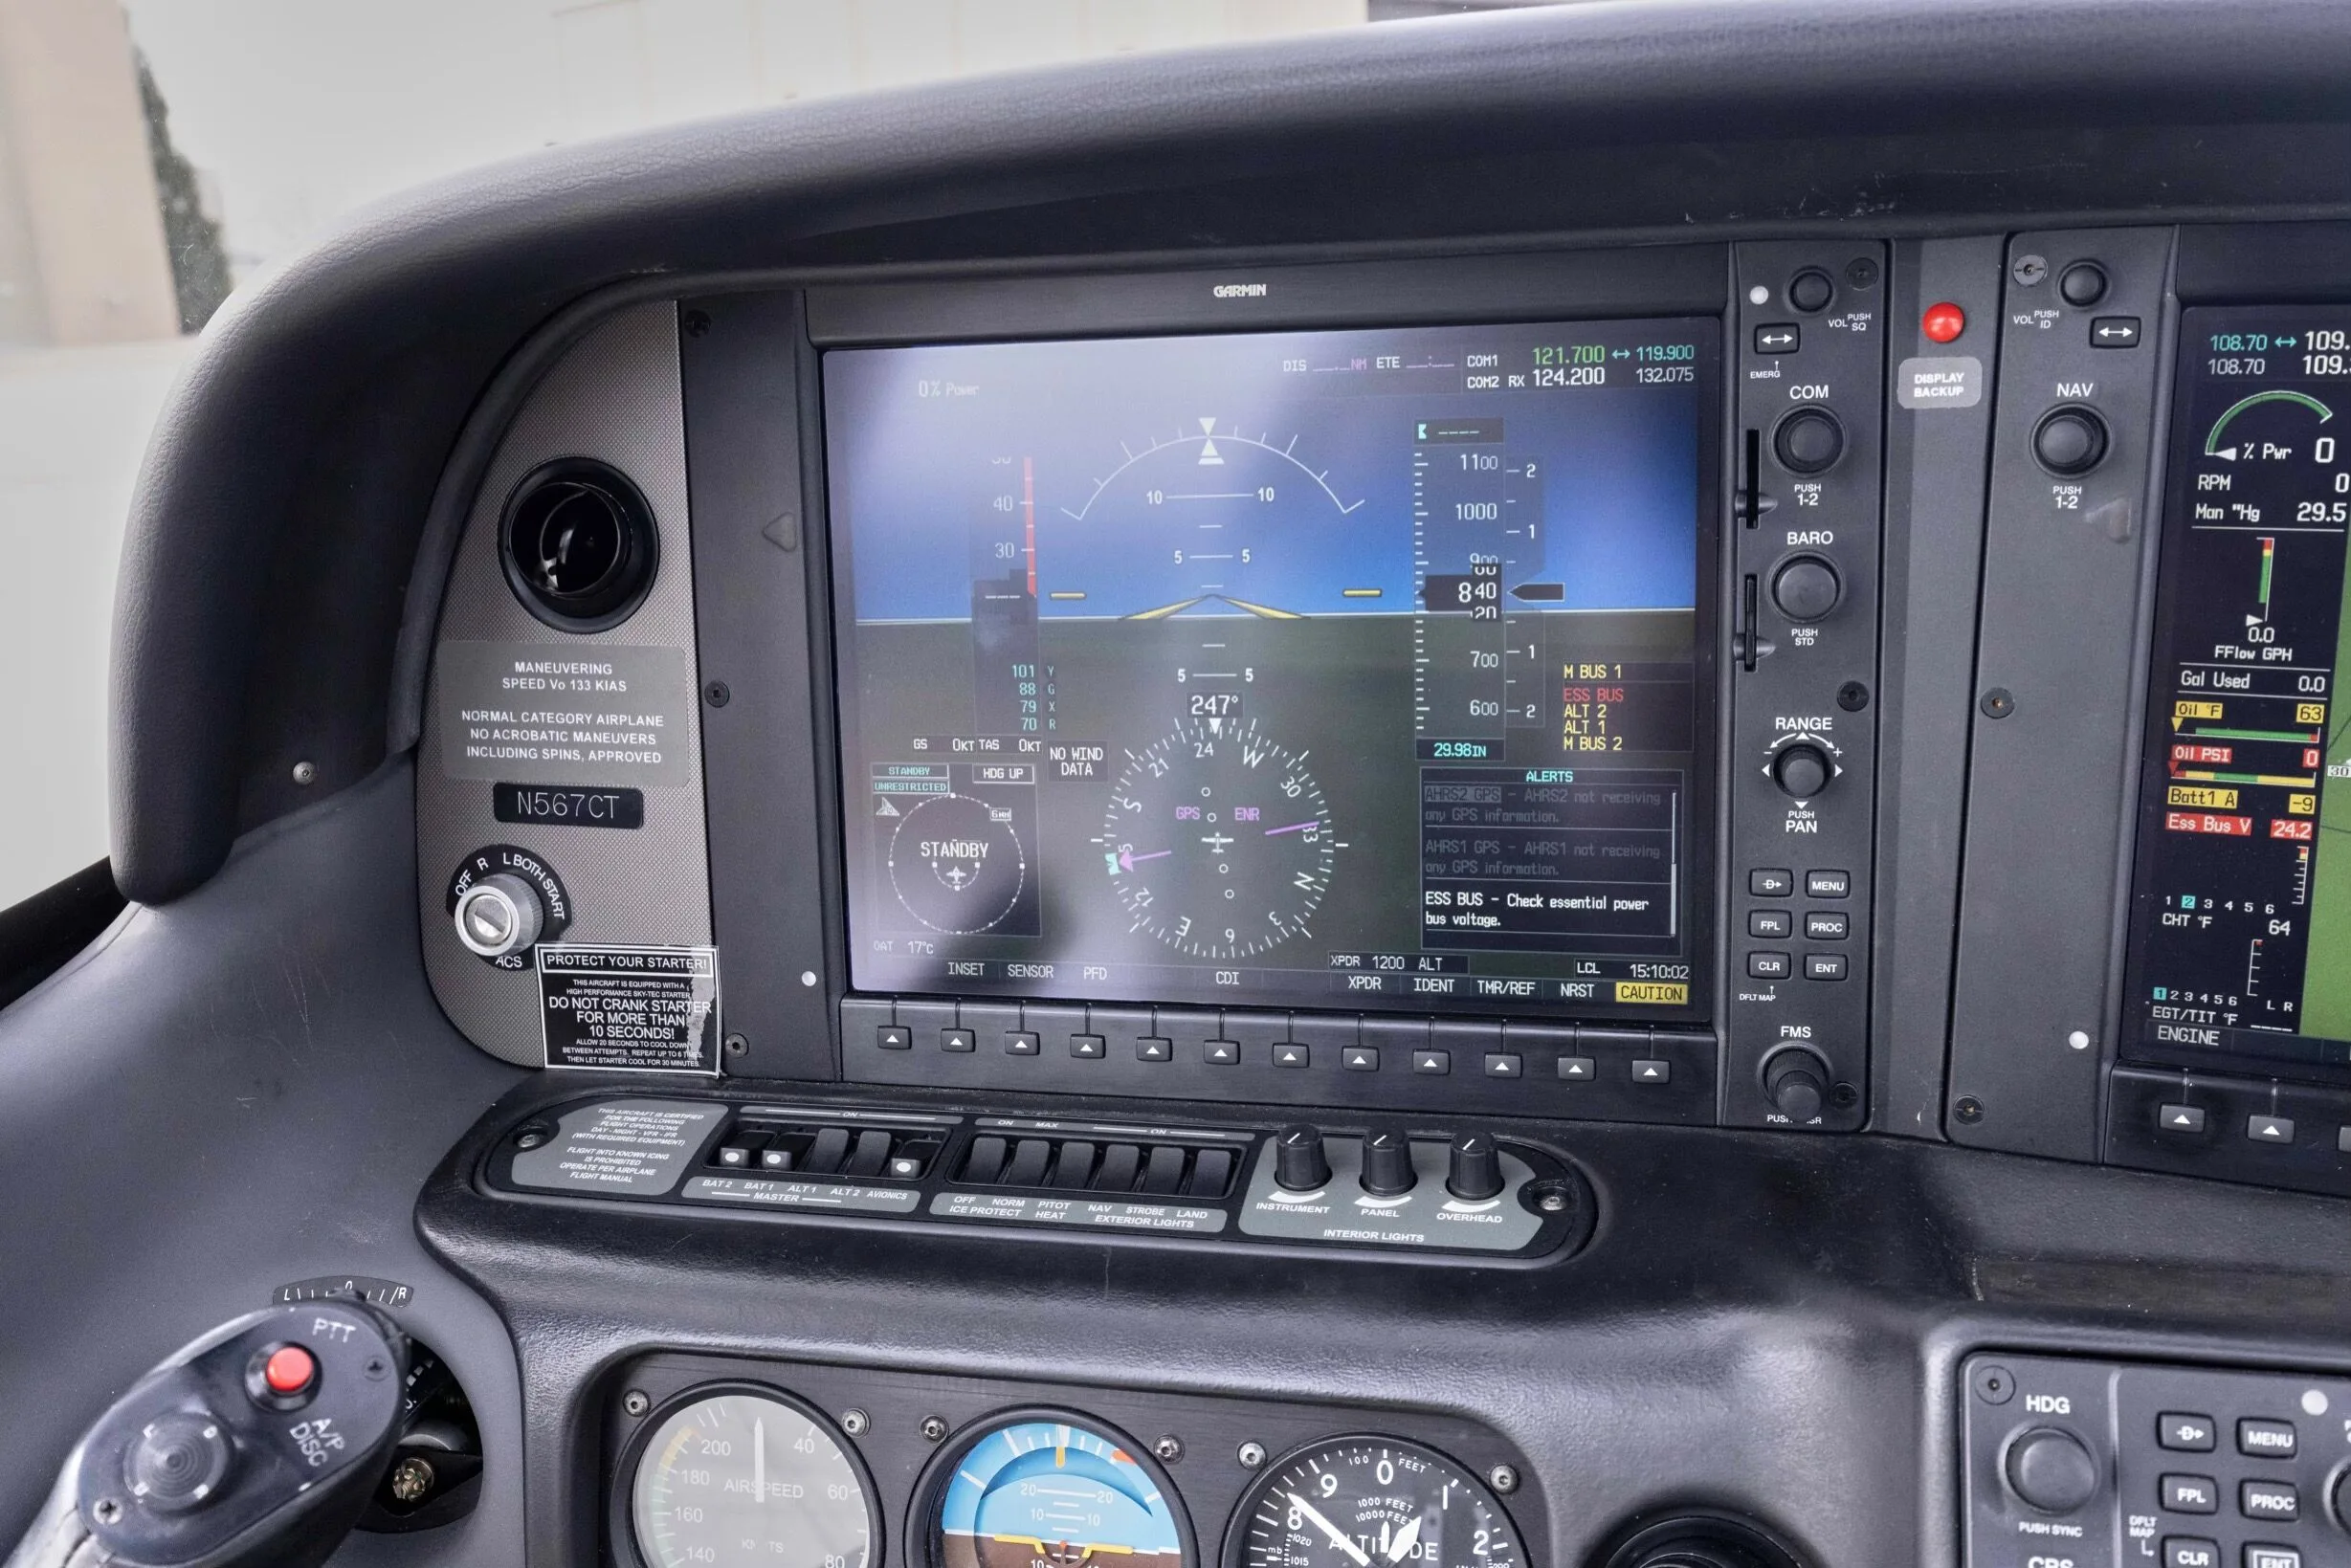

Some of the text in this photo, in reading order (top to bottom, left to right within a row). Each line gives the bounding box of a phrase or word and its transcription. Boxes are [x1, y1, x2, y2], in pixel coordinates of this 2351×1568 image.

[1214, 284, 1266, 297] GARMIN
[1848, 313, 1872, 322] PUSH
[2034, 311, 2059, 320] PUSH
[1829, 320, 1848, 328] VOL
[2210, 335, 2268, 351] 108.70
[1467, 355, 1497, 367] COM1
[1533, 345, 1694, 364] 121.700 119.900
[1377, 357, 1400, 368] ETE
[1467, 376, 1499, 387] COM2
[1533, 367, 1694, 386] 124.200 132.075
[1750, 370, 1781, 380] EMERG
[1915, 373, 1964, 385] DISPLAY
[946, 383, 979, 396] Power
[1789, 386, 1829, 399] COM
[1914, 386, 1964, 398] BACKUP
[2056, 384, 2093, 397] NAV
[2263, 444, 2292, 459] Pwr
[1794, 484, 1821, 493] PUSH
[2198, 475, 2231, 491] RPM
[1797, 494, 1818, 506] 1-2
[1456, 503, 1497, 520] 1000
[2196, 502, 2347, 521] Man 29.5
[1786, 532, 1833, 544] BARO
[2249, 627, 2274, 643] 0.0
[2215, 645, 2292, 661] FFlow GPH
[515, 662, 611, 674] MANEUVERING
[1012, 665, 1034, 676] 101
[1581, 666, 1607, 678] BUS
[502, 678, 627, 692] SPEED 133 KIAS
[2181, 671, 2250, 689] Gal Used
[1564, 689, 1624, 701] ESS BUS
[1470, 700, 1497, 716] 600
[1564, 705, 1590, 718] ALT
[2179, 704, 2321, 720] Oil 63
[462, 711, 663, 726] NORMAL CATEGORY AIRPLANE
[1775, 718, 1832, 730] RANGE
[1564, 721, 1590, 734] ALT
[471, 729, 655, 744] NO ACROBATIC MANEUVERS
[1434, 743, 1486, 757] 29.98IN
[1581, 738, 1606, 750] BUS
[467, 746, 661, 762] INCLUDING SPINS, APPROVED
[1073, 748, 1102, 760] WIND
[2202, 748, 2230, 762] PSI
[984, 769, 1003, 779] HDG
[1062, 763, 1093, 776] DATA
[1526, 772, 1573, 783] ALERTS
[875, 783, 946, 791] UNRESTRICTED
[1426, 788, 1660, 806] AHRS2 receiving
[2171, 789, 2215, 805] Batt1
[518, 792, 619, 818] N567CT
[1176, 807, 1200, 820] GPS
[1785, 821, 1817, 832] PAN
[2168, 814, 2311, 838] Ess Bus 24.2
[513, 854, 545, 880] BOTH
[455, 870, 473, 895] OFF
[1812, 881, 1844, 892] MENU
[543, 878, 565, 919] START
[1507, 894, 1649, 912] Check essential power
[1426, 912, 1500, 927] bus voltage.
[1761, 920, 1780, 930] FPL
[2162, 913, 2190, 926] CHT
[1811, 922, 1842, 932] PROC
[496, 957, 522, 967] ACS
[547, 956, 706, 969] PROTECT YOUR STARTER!
[1373, 957, 1441, 970] 1200 ALT
[1759, 961, 1780, 971] CLR
[1816, 964, 1837, 973] ENT
[948, 962, 1053, 978] INSET SENSOR
[1630, 964, 1688, 979] 15:10:02
[1414, 979, 1682, 1000] IDENT TMR/REF NRST CAUTION
[549, 997, 711, 1013] DO NOT CRANK STARTER
[577, 1011, 685, 1026] FOR MORE THAN
[2153, 1006, 2216, 1024] EGT/TIT
[589, 1026, 675, 1039] 10 SECONDS!
[1781, 1027, 1811, 1038] FMS
[2158, 1026, 2220, 1046] ENGINE
[754, 1193, 799, 1202] MASTER
[867, 1191, 907, 1200] AVIONICS
[992, 1199, 1025, 1207] NORM
[1256, 1203, 1330, 1214] INSTRUMENT
[970, 1207, 1022, 1217] PROTECT
[1126, 1206, 1164, 1216] STROBE
[1177, 1210, 1208, 1219] LAND
[1362, 1209, 1400, 1218] PANEL
[1095, 1215, 1194, 1227] EXTERIOR LIGHTS
[1437, 1213, 1502, 1223] OVERHEAD
[1323, 1229, 1380, 1240] INTERIOR
[312, 1318, 356, 1343] PTT
[311, 1418, 345, 1450] A/P
[290, 1422, 327, 1468] DISC
[701, 1440, 731, 1456] 200
[794, 1439, 814, 1453] 40
[1349, 1456, 1427, 1473] 100 FEET
[681, 1470, 709, 1485] 180
[1021, 1485, 1036, 1495] 20
[2052, 1525, 2082, 1537] SYNC
